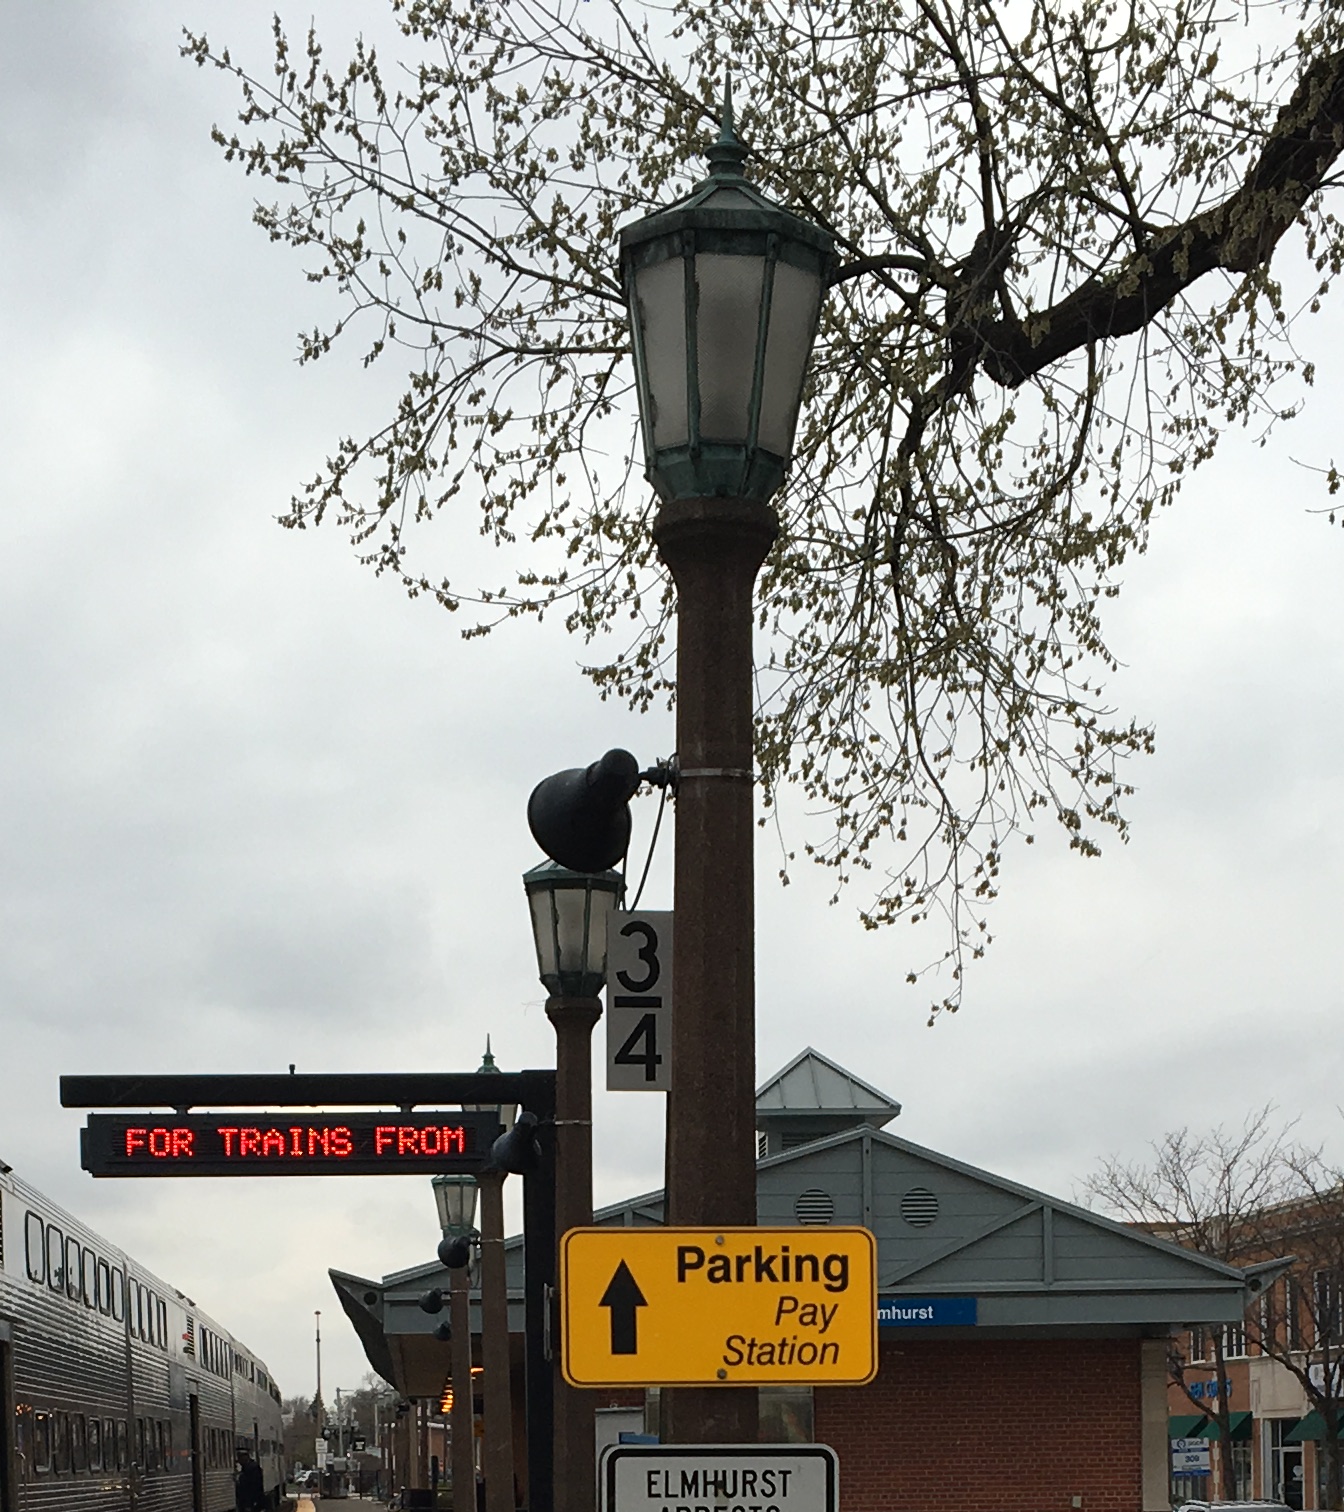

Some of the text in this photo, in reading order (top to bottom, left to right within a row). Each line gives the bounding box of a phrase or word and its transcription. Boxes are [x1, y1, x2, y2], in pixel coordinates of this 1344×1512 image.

[616, 920, 661, 993] 3
[614, 1013, 663, 1082] 4
[125, 1124, 466, 1157] FOR TRAINS FROM
[675, 1244, 850, 1293] Parking
[774, 1295, 840, 1335] Pay
[877, 1305, 935, 1321] mhurst
[721, 1334, 840, 1367] Station
[646, 1469, 793, 1499] ELMHURST
